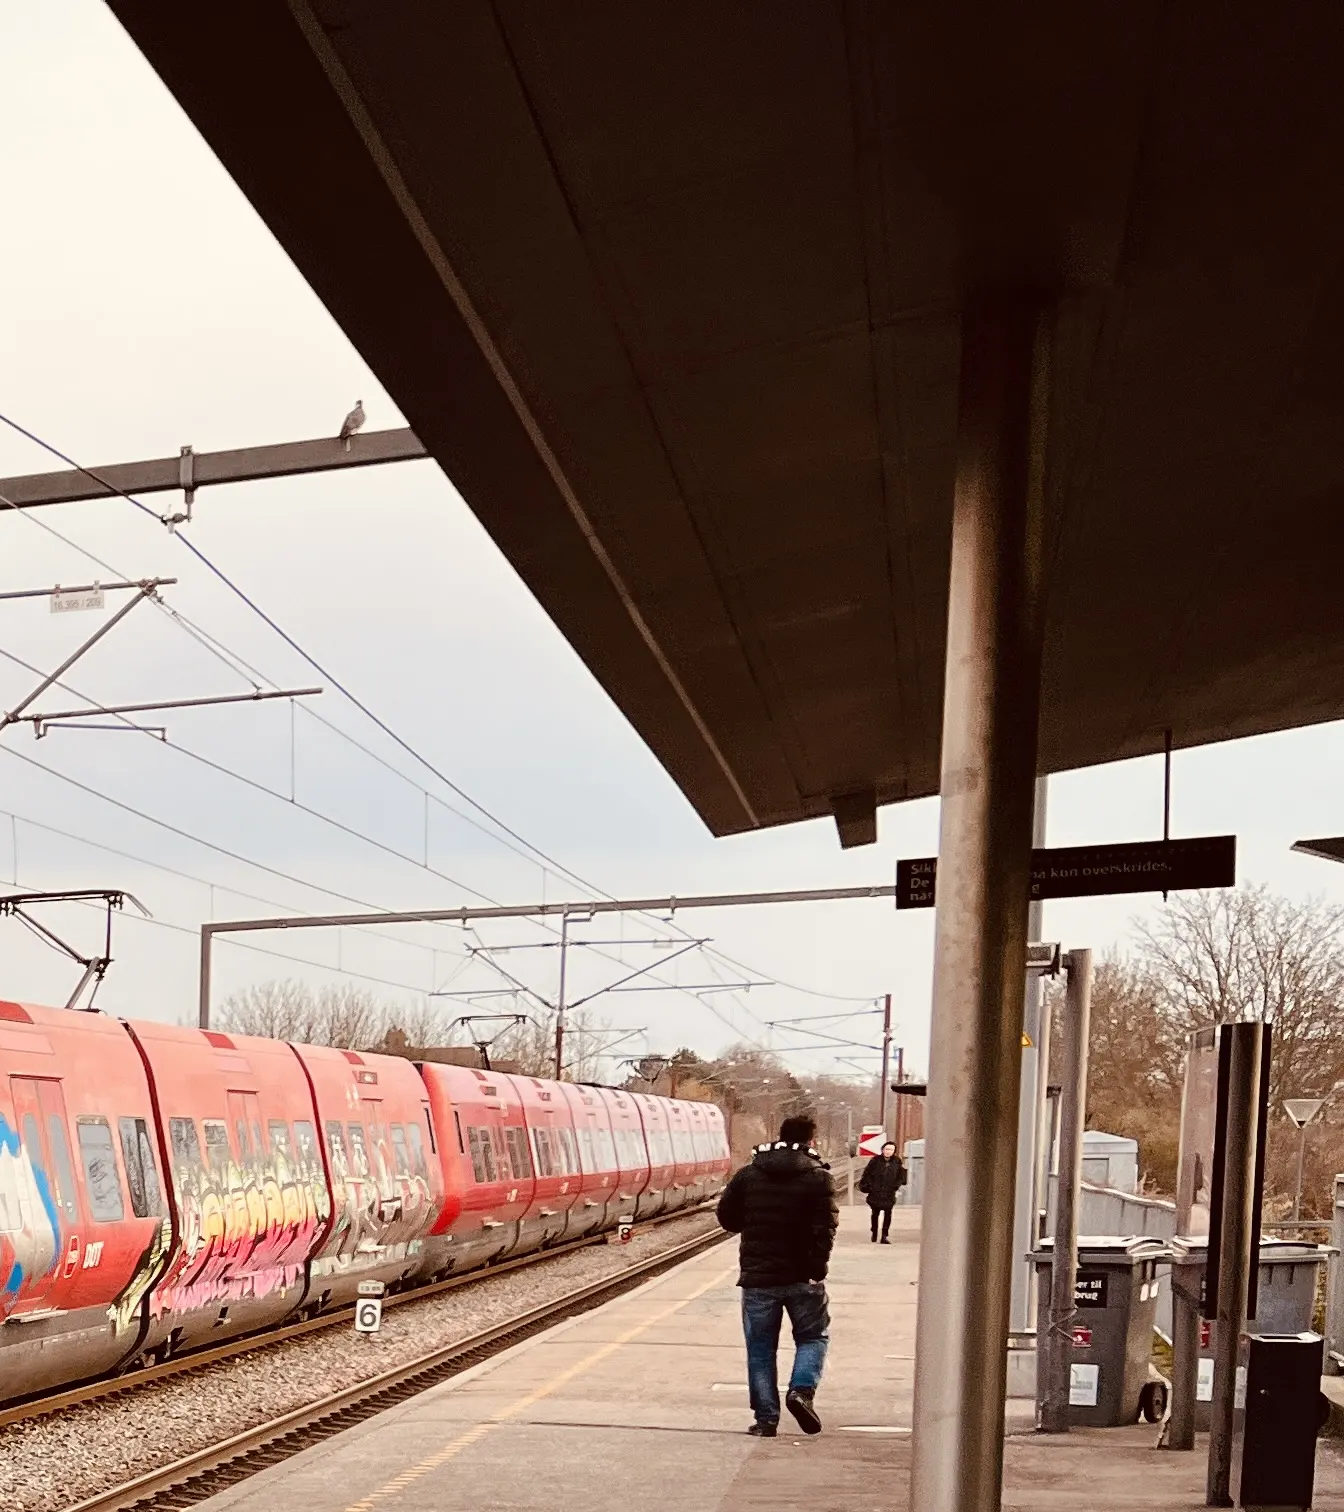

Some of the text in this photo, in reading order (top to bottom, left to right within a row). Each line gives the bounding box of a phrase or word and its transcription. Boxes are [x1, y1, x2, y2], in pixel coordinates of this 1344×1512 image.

[910, 878, 929, 888] De
[1050, 867, 1078, 878] kun
[83, 1241, 104, 1269] DOT
[359, 1303, 377, 1327] 6
